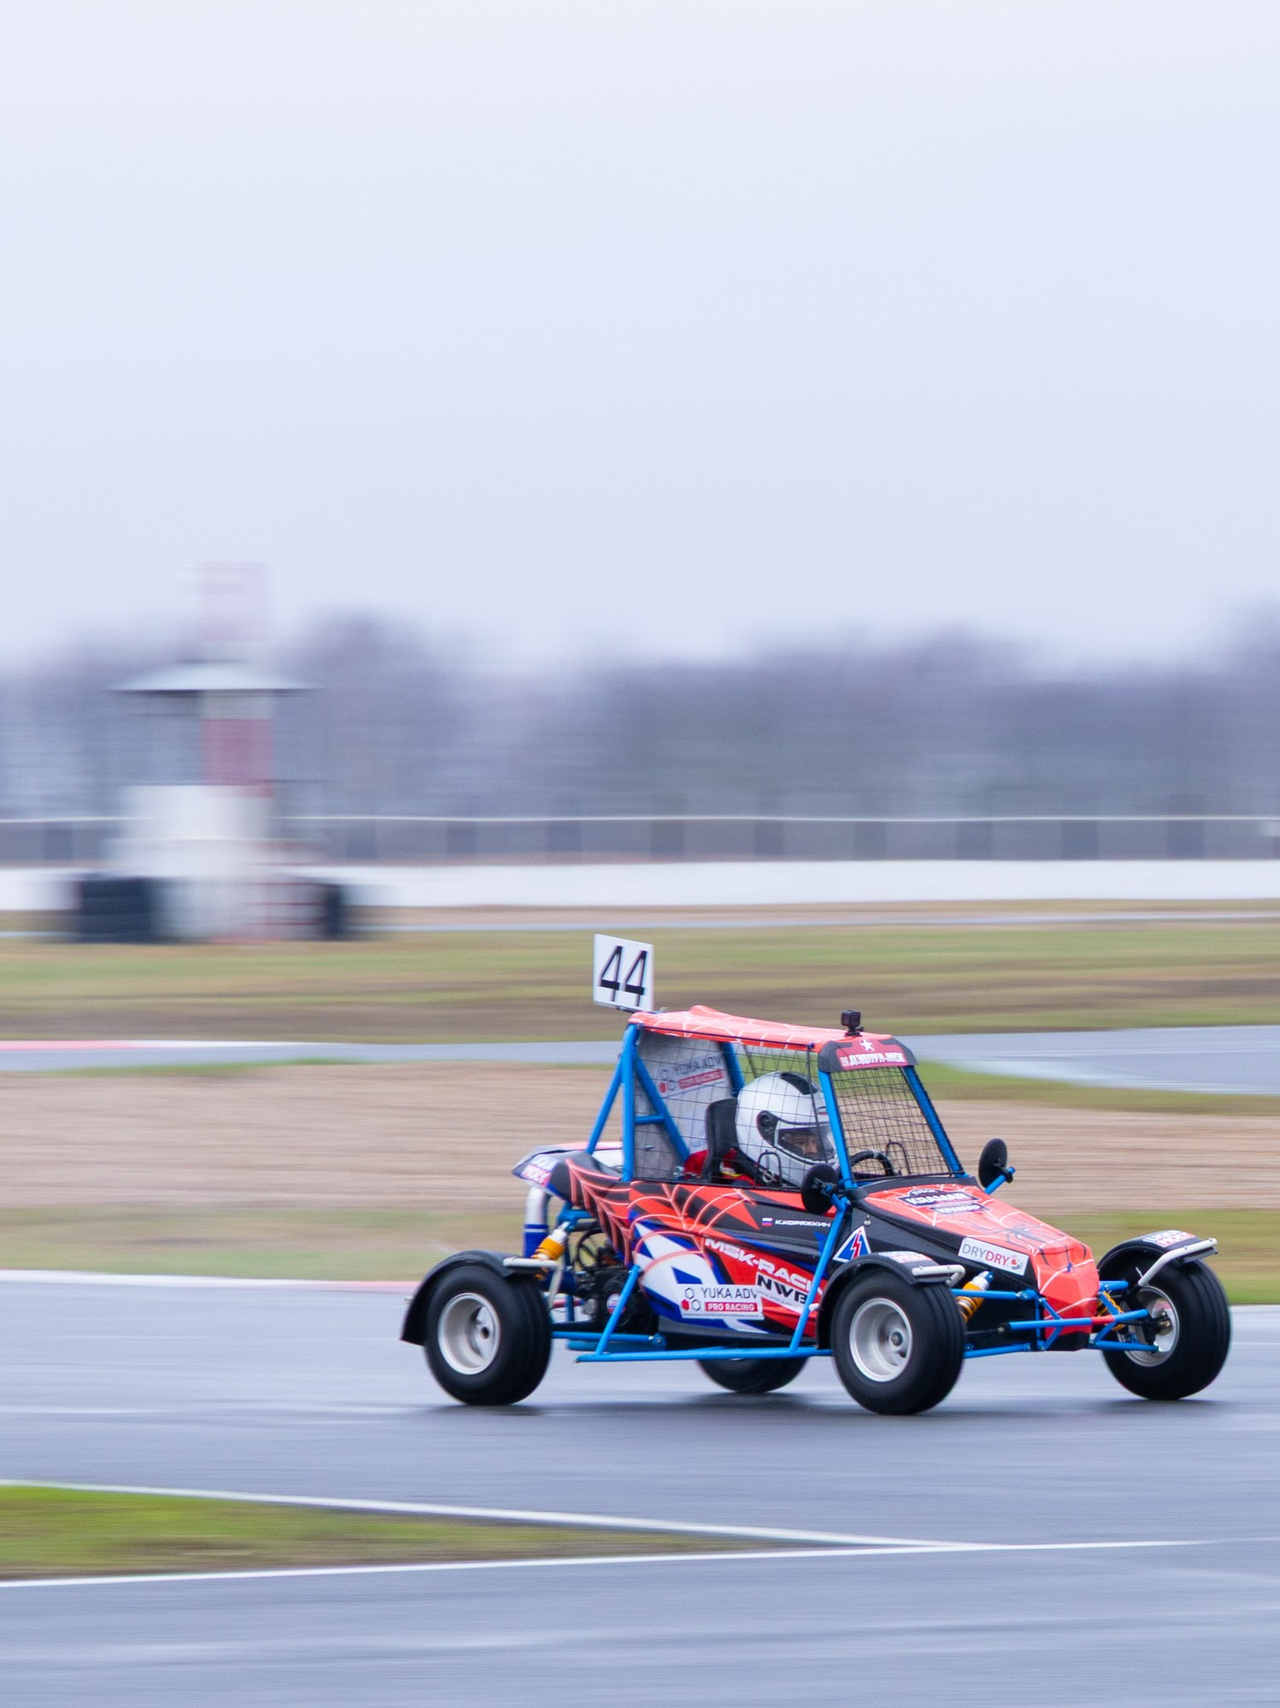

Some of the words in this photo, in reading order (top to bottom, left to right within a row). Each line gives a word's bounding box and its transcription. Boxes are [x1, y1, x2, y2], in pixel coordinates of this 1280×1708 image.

[599, 945, 648, 1007] 44
[701, 1287, 732, 1299] YUKA
[708, 1303, 723, 1311] PRO
[725, 1303, 755, 1312] RACING
